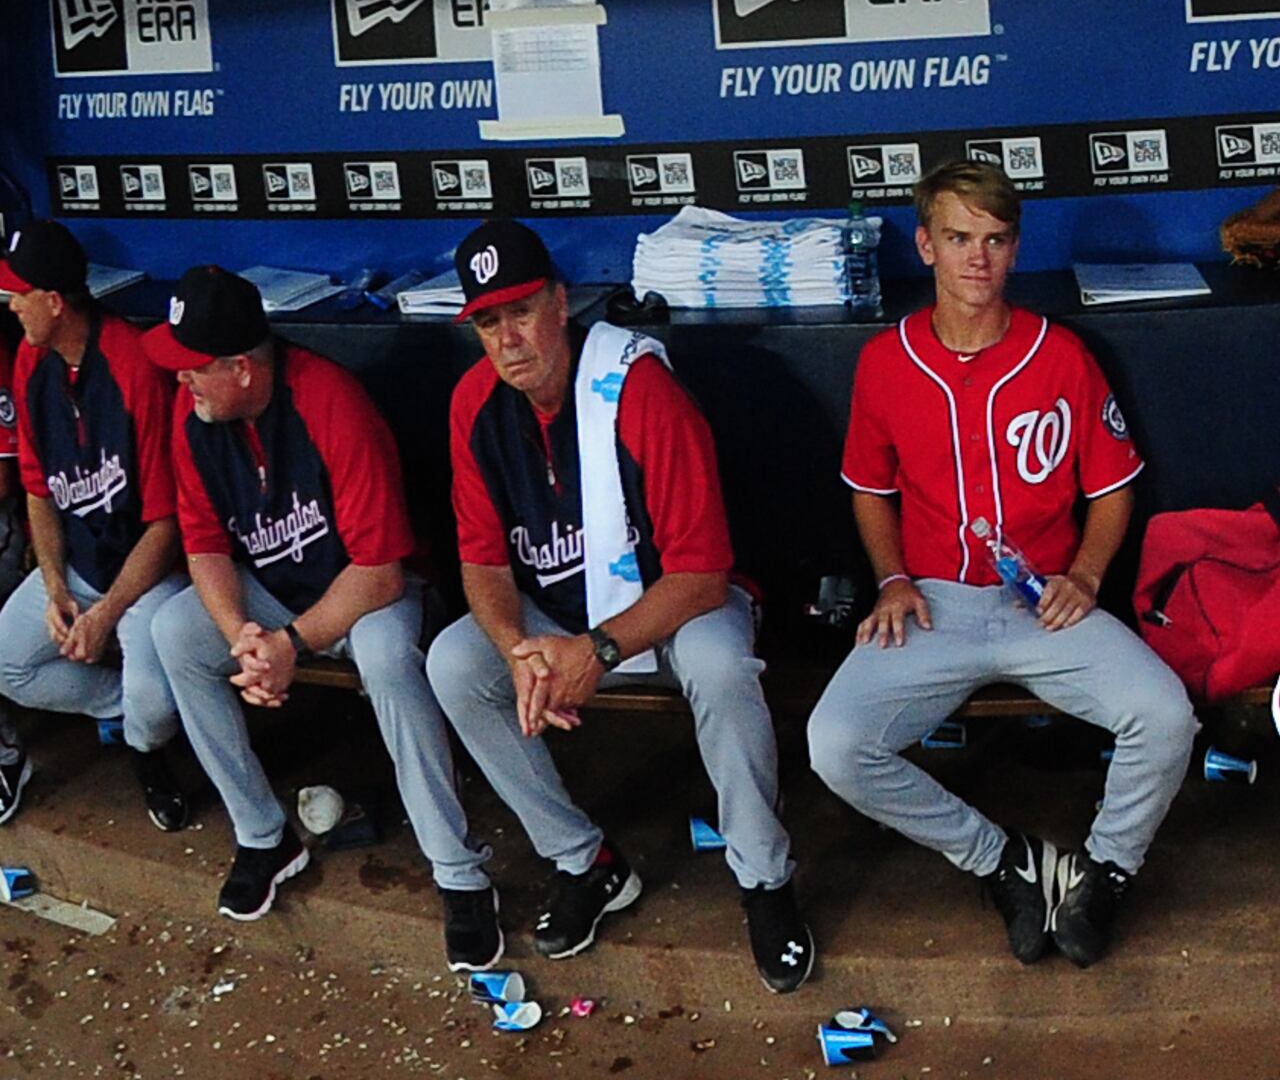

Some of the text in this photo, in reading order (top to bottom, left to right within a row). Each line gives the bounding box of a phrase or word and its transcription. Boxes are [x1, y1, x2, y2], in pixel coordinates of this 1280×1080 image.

[136, 3, 196, 44] ERA
[1189, 38, 1238, 73] FLY
[339, 78, 493, 113] FLY YOUR OWN
[719, 54, 991, 99] FLY YOUR OWN FLAG
[58, 88, 215, 119] FLY YOUR OWN FLAG
[470, 244, 499, 286] W
[1006, 397, 1071, 485] W
[48, 453, 126, 514] Washington
